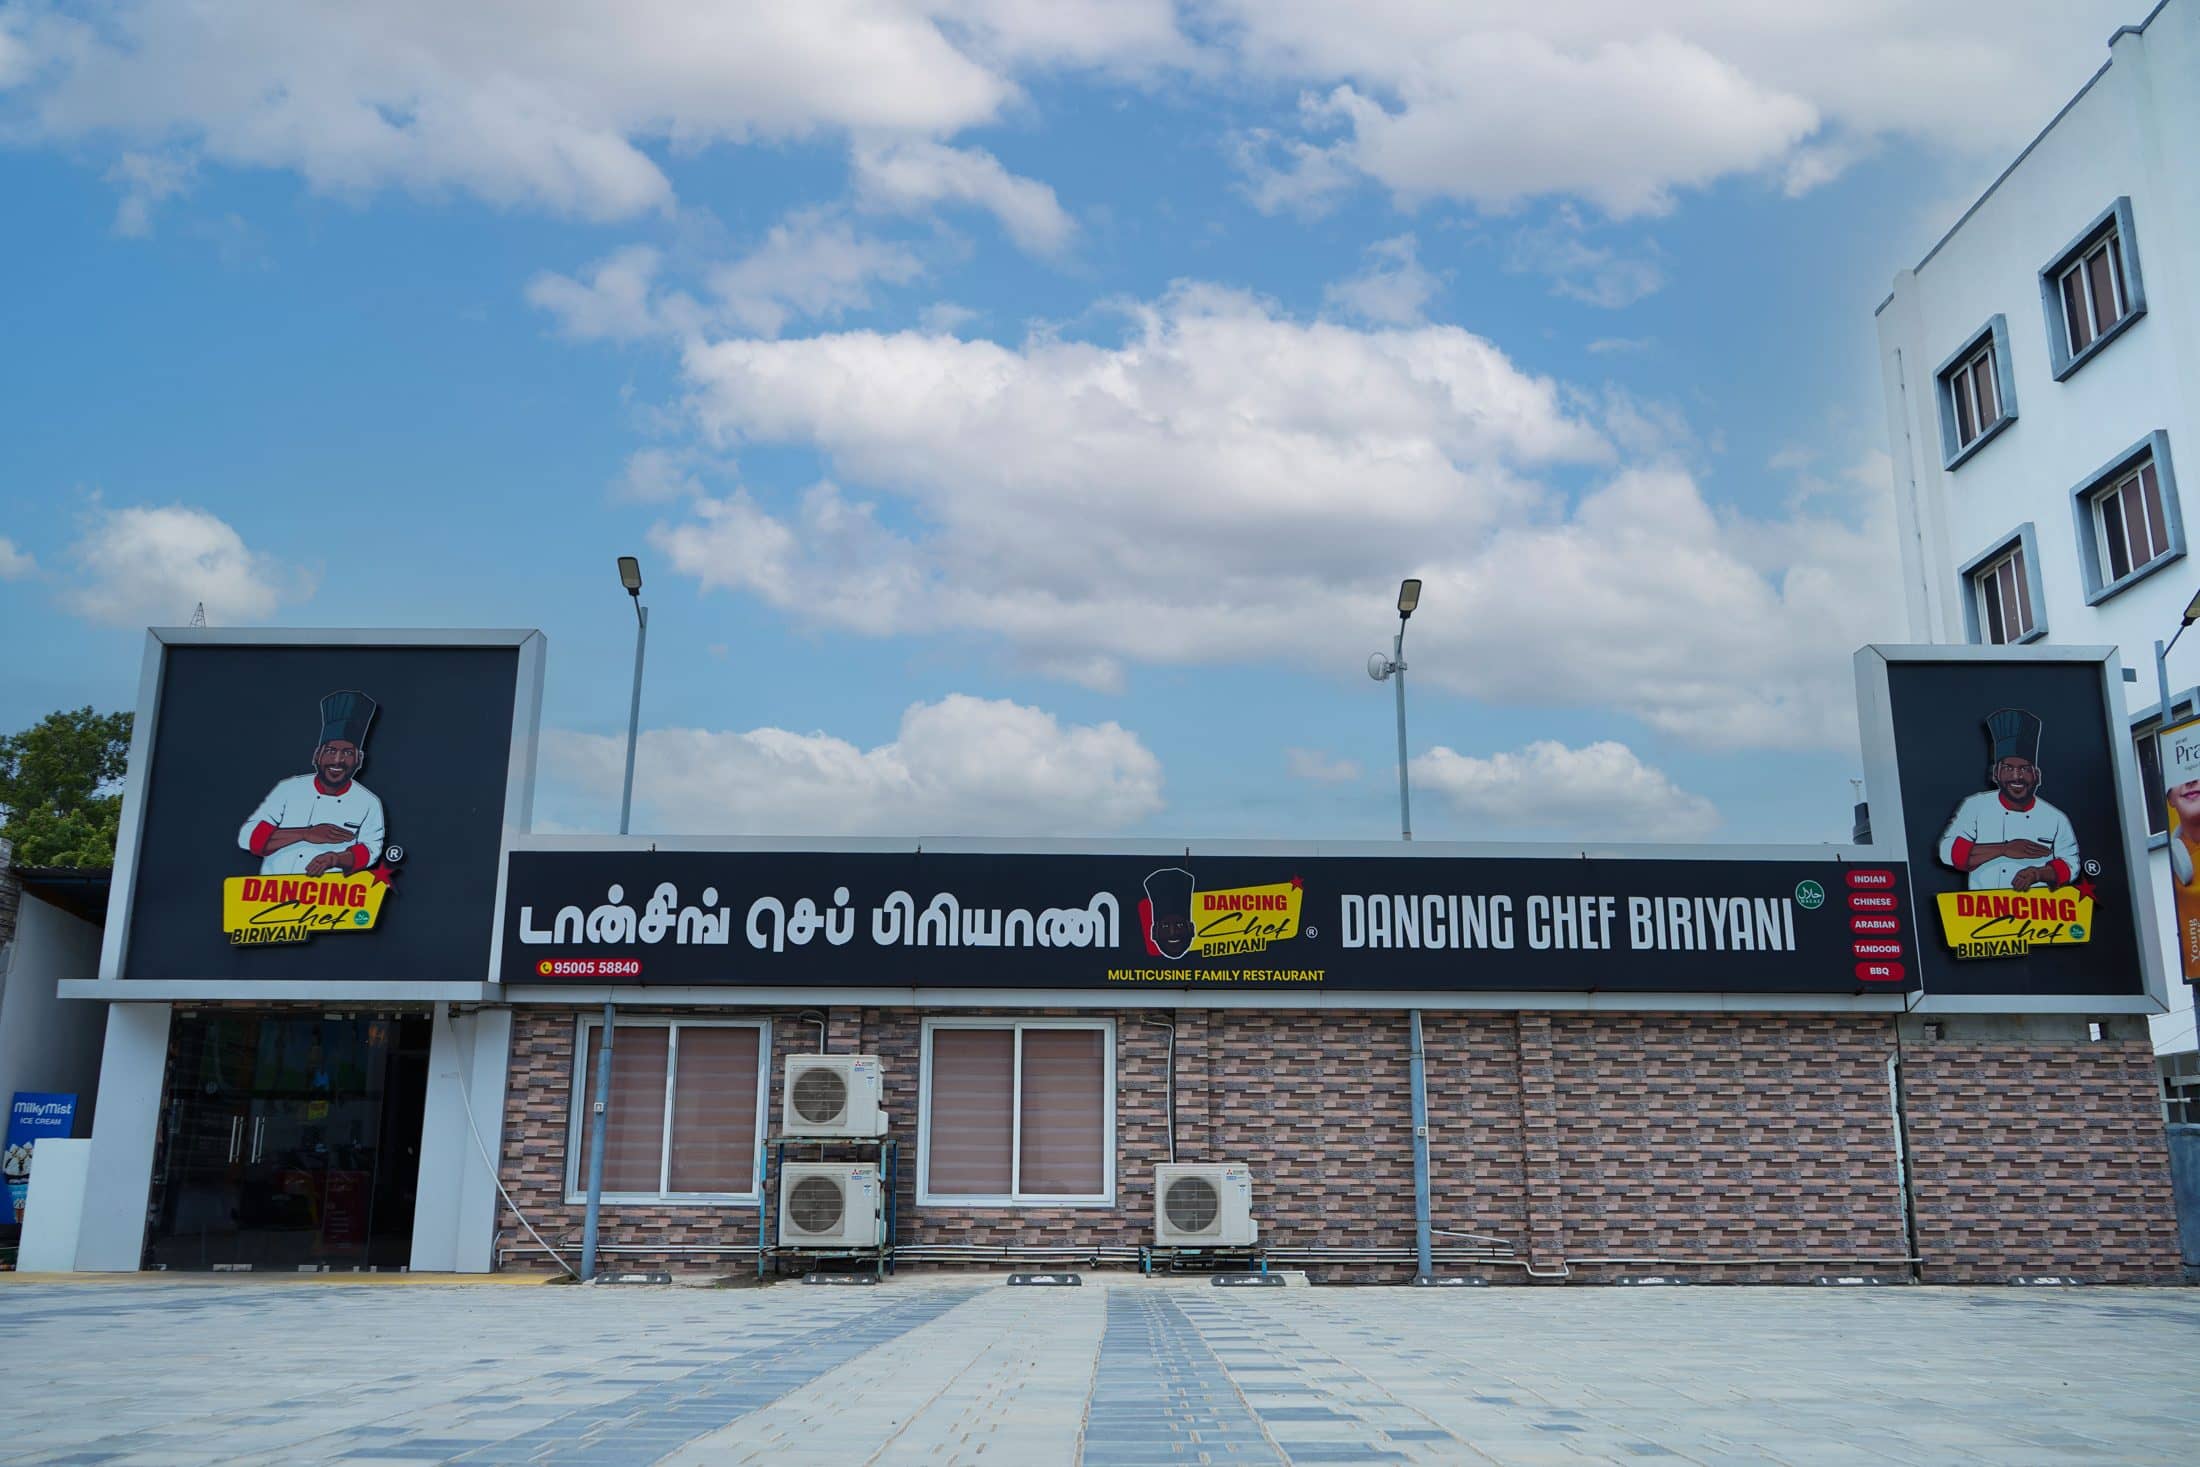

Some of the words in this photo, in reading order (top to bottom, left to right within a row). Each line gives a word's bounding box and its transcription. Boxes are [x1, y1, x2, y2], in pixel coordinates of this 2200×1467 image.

[1854, 875, 1887, 884] INDIAN
[241, 878, 367, 908] DANCING
[1853, 897, 1892, 907] CHINESE
[1203, 894, 1288, 912] DANCING
[1956, 894, 2077, 922] DANCING
[249, 900, 350, 930] Chef
[519, 882, 730, 945] டான்சிங்
[746, 886, 855, 953] செப்
[872, 890, 1120, 948] பிரியாணி
[1198, 911, 1290, 938] Chef
[1340, 893, 1514, 949] DANCING
[1527, 894, 1616, 949] CHEF
[1628, 896, 1796, 951] BIRIYANI
[1855, 920, 1896, 929] ARABIAN
[231, 925, 308, 945] BIRIYANI
[1970, 914, 2065, 943] Chef
[1203, 938, 1267, 957] BIRIYANI
[1855, 945, 1900, 953] TANDOORI
[1958, 939, 2028, 958] BIRIYANI
[554, 961, 595, 974] 95005
[598, 961, 639, 974] 58840
[1108, 969, 1192, 981] MULTICUSINE
[1194, 969, 1241, 981] FAMILY
[1243, 970, 1325, 981] RESTAURANT
[1870, 967, 1890, 976] BBQ
[20, 1117, 34, 1125] ICE
[35, 1117, 62, 1126] CREAM
